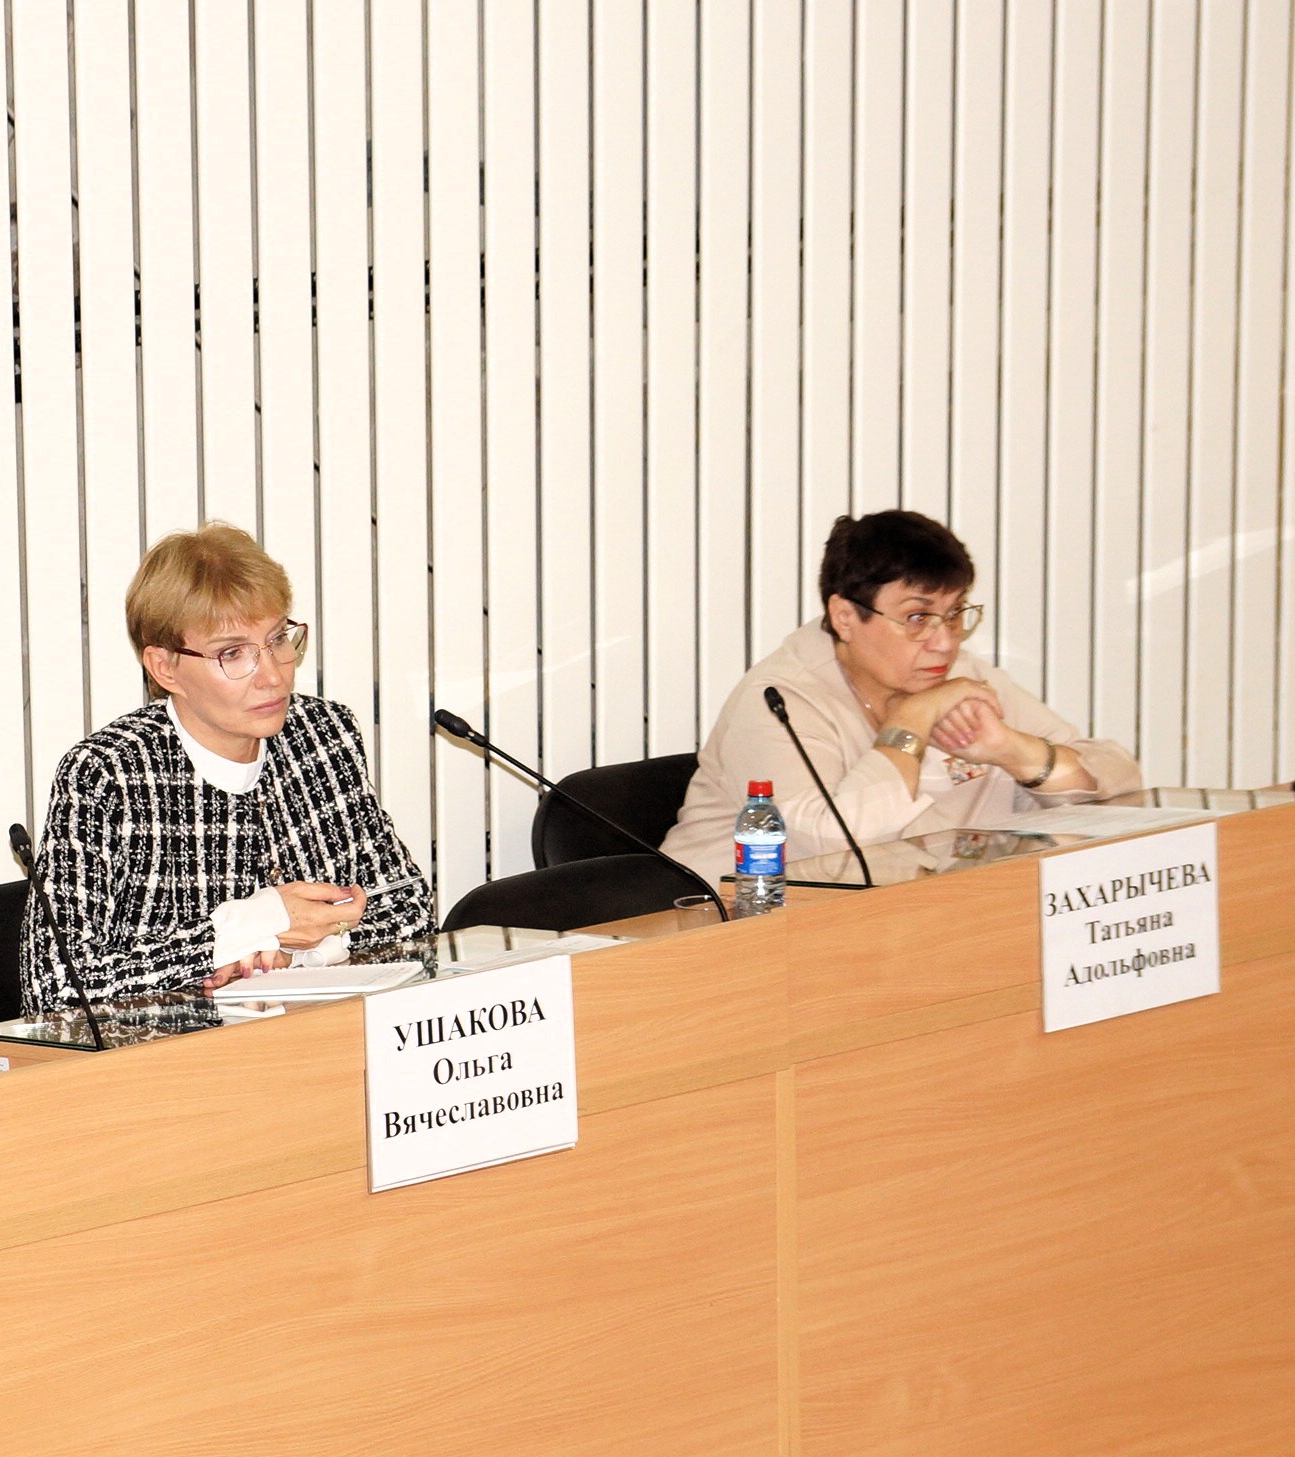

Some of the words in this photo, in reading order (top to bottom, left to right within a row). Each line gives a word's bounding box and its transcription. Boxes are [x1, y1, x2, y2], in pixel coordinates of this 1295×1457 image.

[1043, 861, 1212, 917] ЗАХАРЫЧЕВА
[1085, 911, 1174, 945] Татьяна
[1063, 942, 1196, 987] Адольфовна
[393, 996, 546, 1051] УШАКОВА
[432, 1051, 513, 1085] Ольга
[383, 1081, 564, 1139] Вячеславовна
